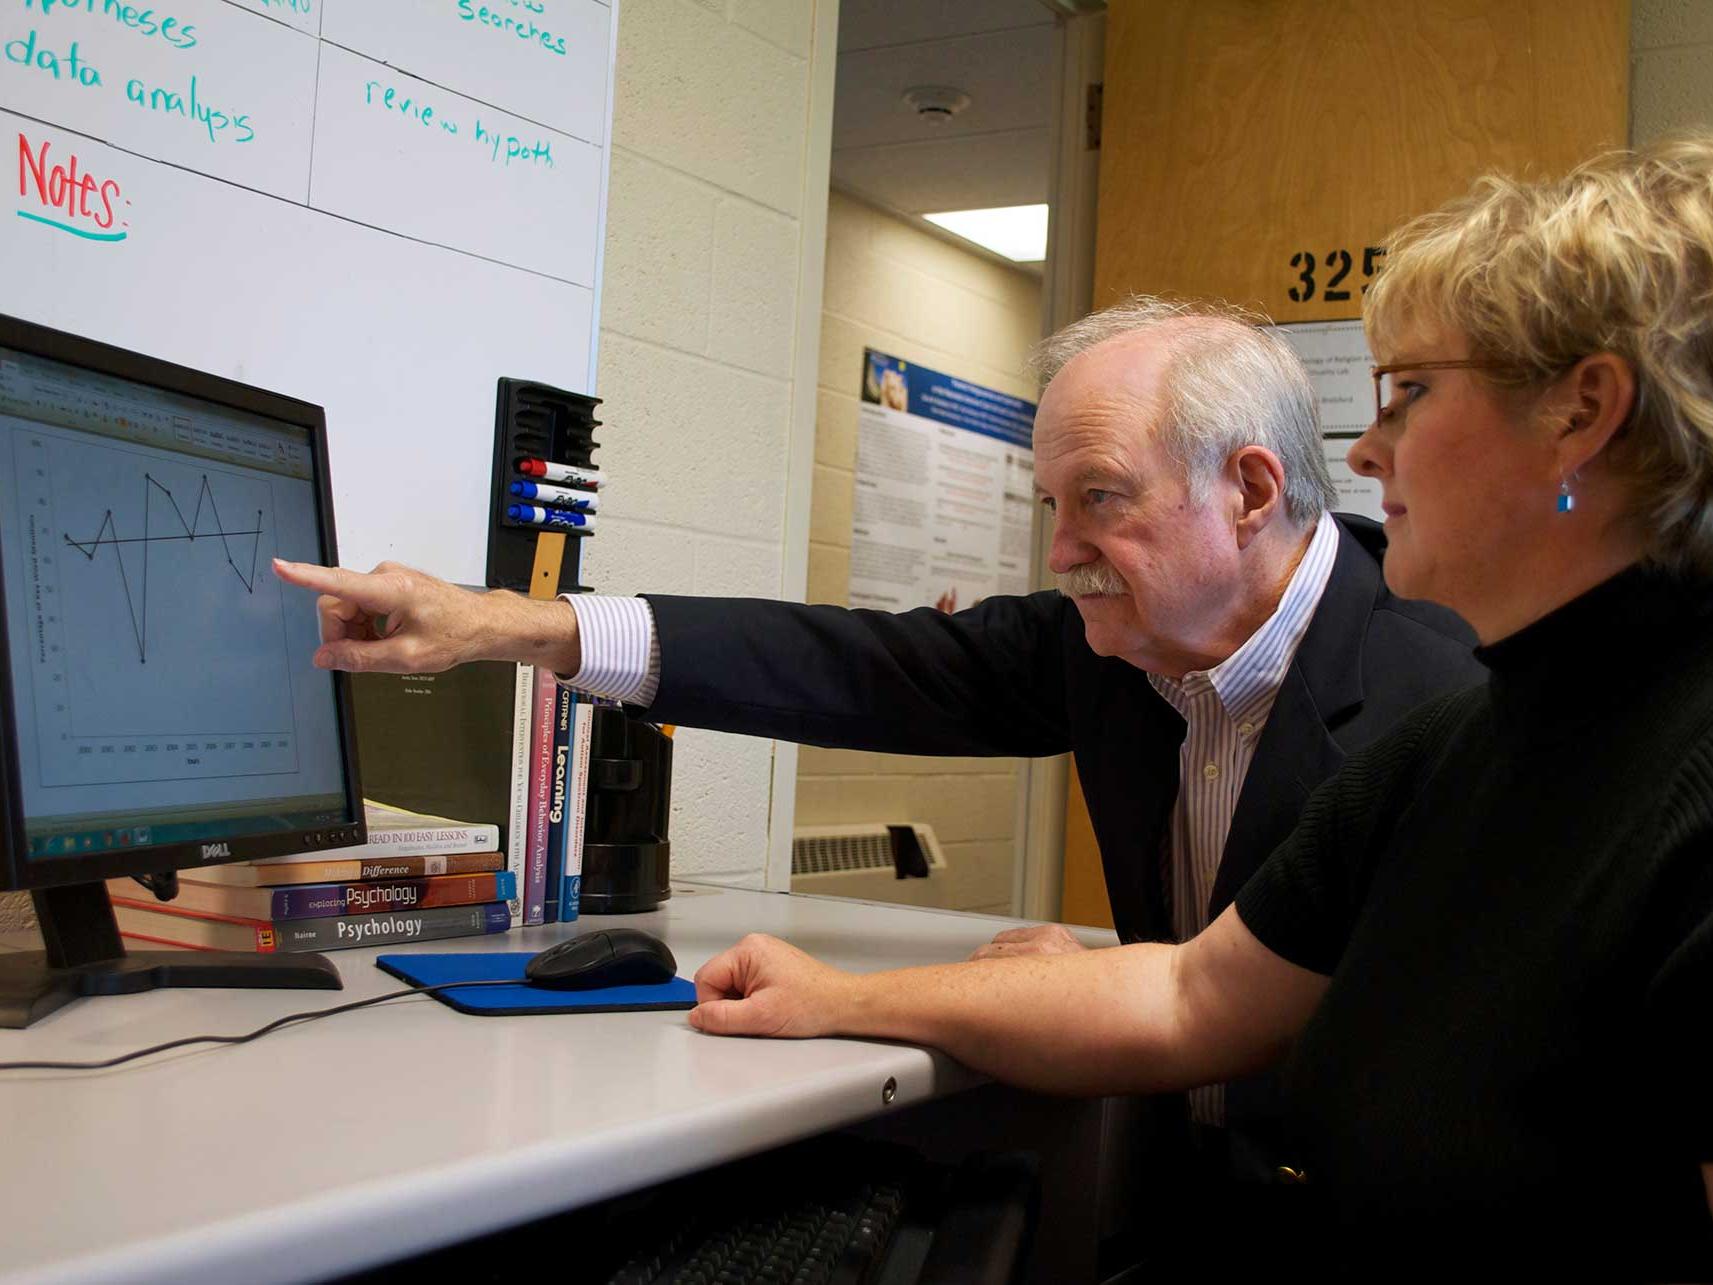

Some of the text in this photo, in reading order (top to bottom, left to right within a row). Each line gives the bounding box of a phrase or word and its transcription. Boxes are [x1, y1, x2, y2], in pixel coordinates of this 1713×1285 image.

[5, 30, 255, 143] data analysis
[366, 80, 554, 169] review hypoth
[18, 133, 132, 229] Notes:
[1287, 247, 1387, 302] 325
[541, 697, 552, 743] Principles
[560, 690, 570, 731] CATANIA
[542, 744, 550, 757] of
[537, 757, 549, 798] Everyday
[549, 745, 569, 824] Learning
[369, 833, 391, 845] READ
[393, 833, 402, 844] IN
[416, 831, 433, 841] EASY
[436, 830, 468, 841] LESSONS
[536, 800, 547, 842] Behavior
[202, 842, 231, 859] DELL
[534, 843, 544, 884] Analysis
[362, 866, 410, 878] Difference
[346, 885, 417, 909] Psychology
[337, 917, 422, 941] Psychology
